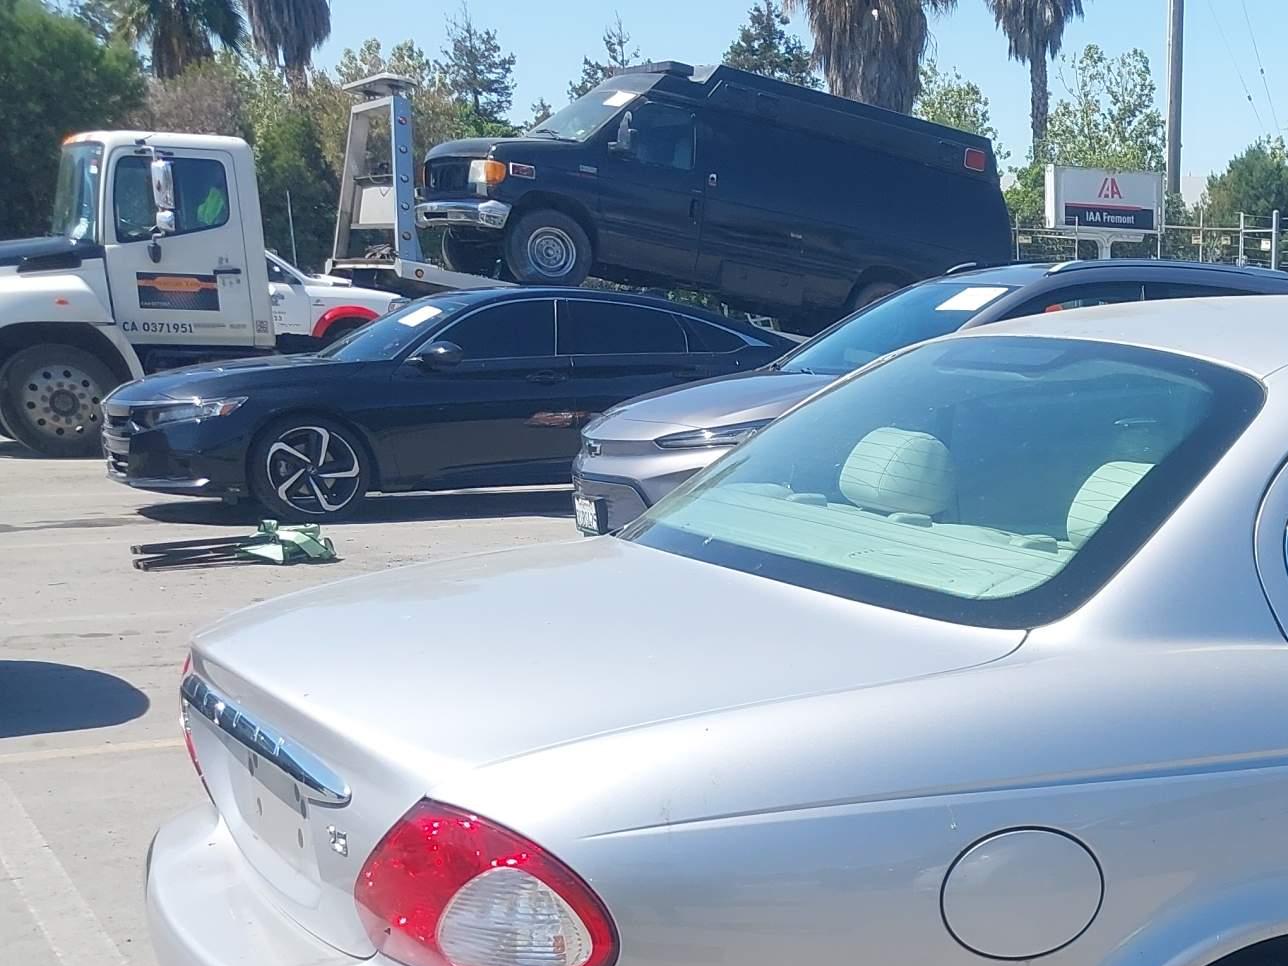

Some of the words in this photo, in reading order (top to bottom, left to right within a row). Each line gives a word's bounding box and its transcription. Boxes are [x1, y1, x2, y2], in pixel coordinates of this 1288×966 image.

[1086, 210, 1101, 222] IAA
[1103, 212, 1135, 225] Fremont
[122, 321, 138, 332] CA
[142, 323, 193, 333] 0371951
